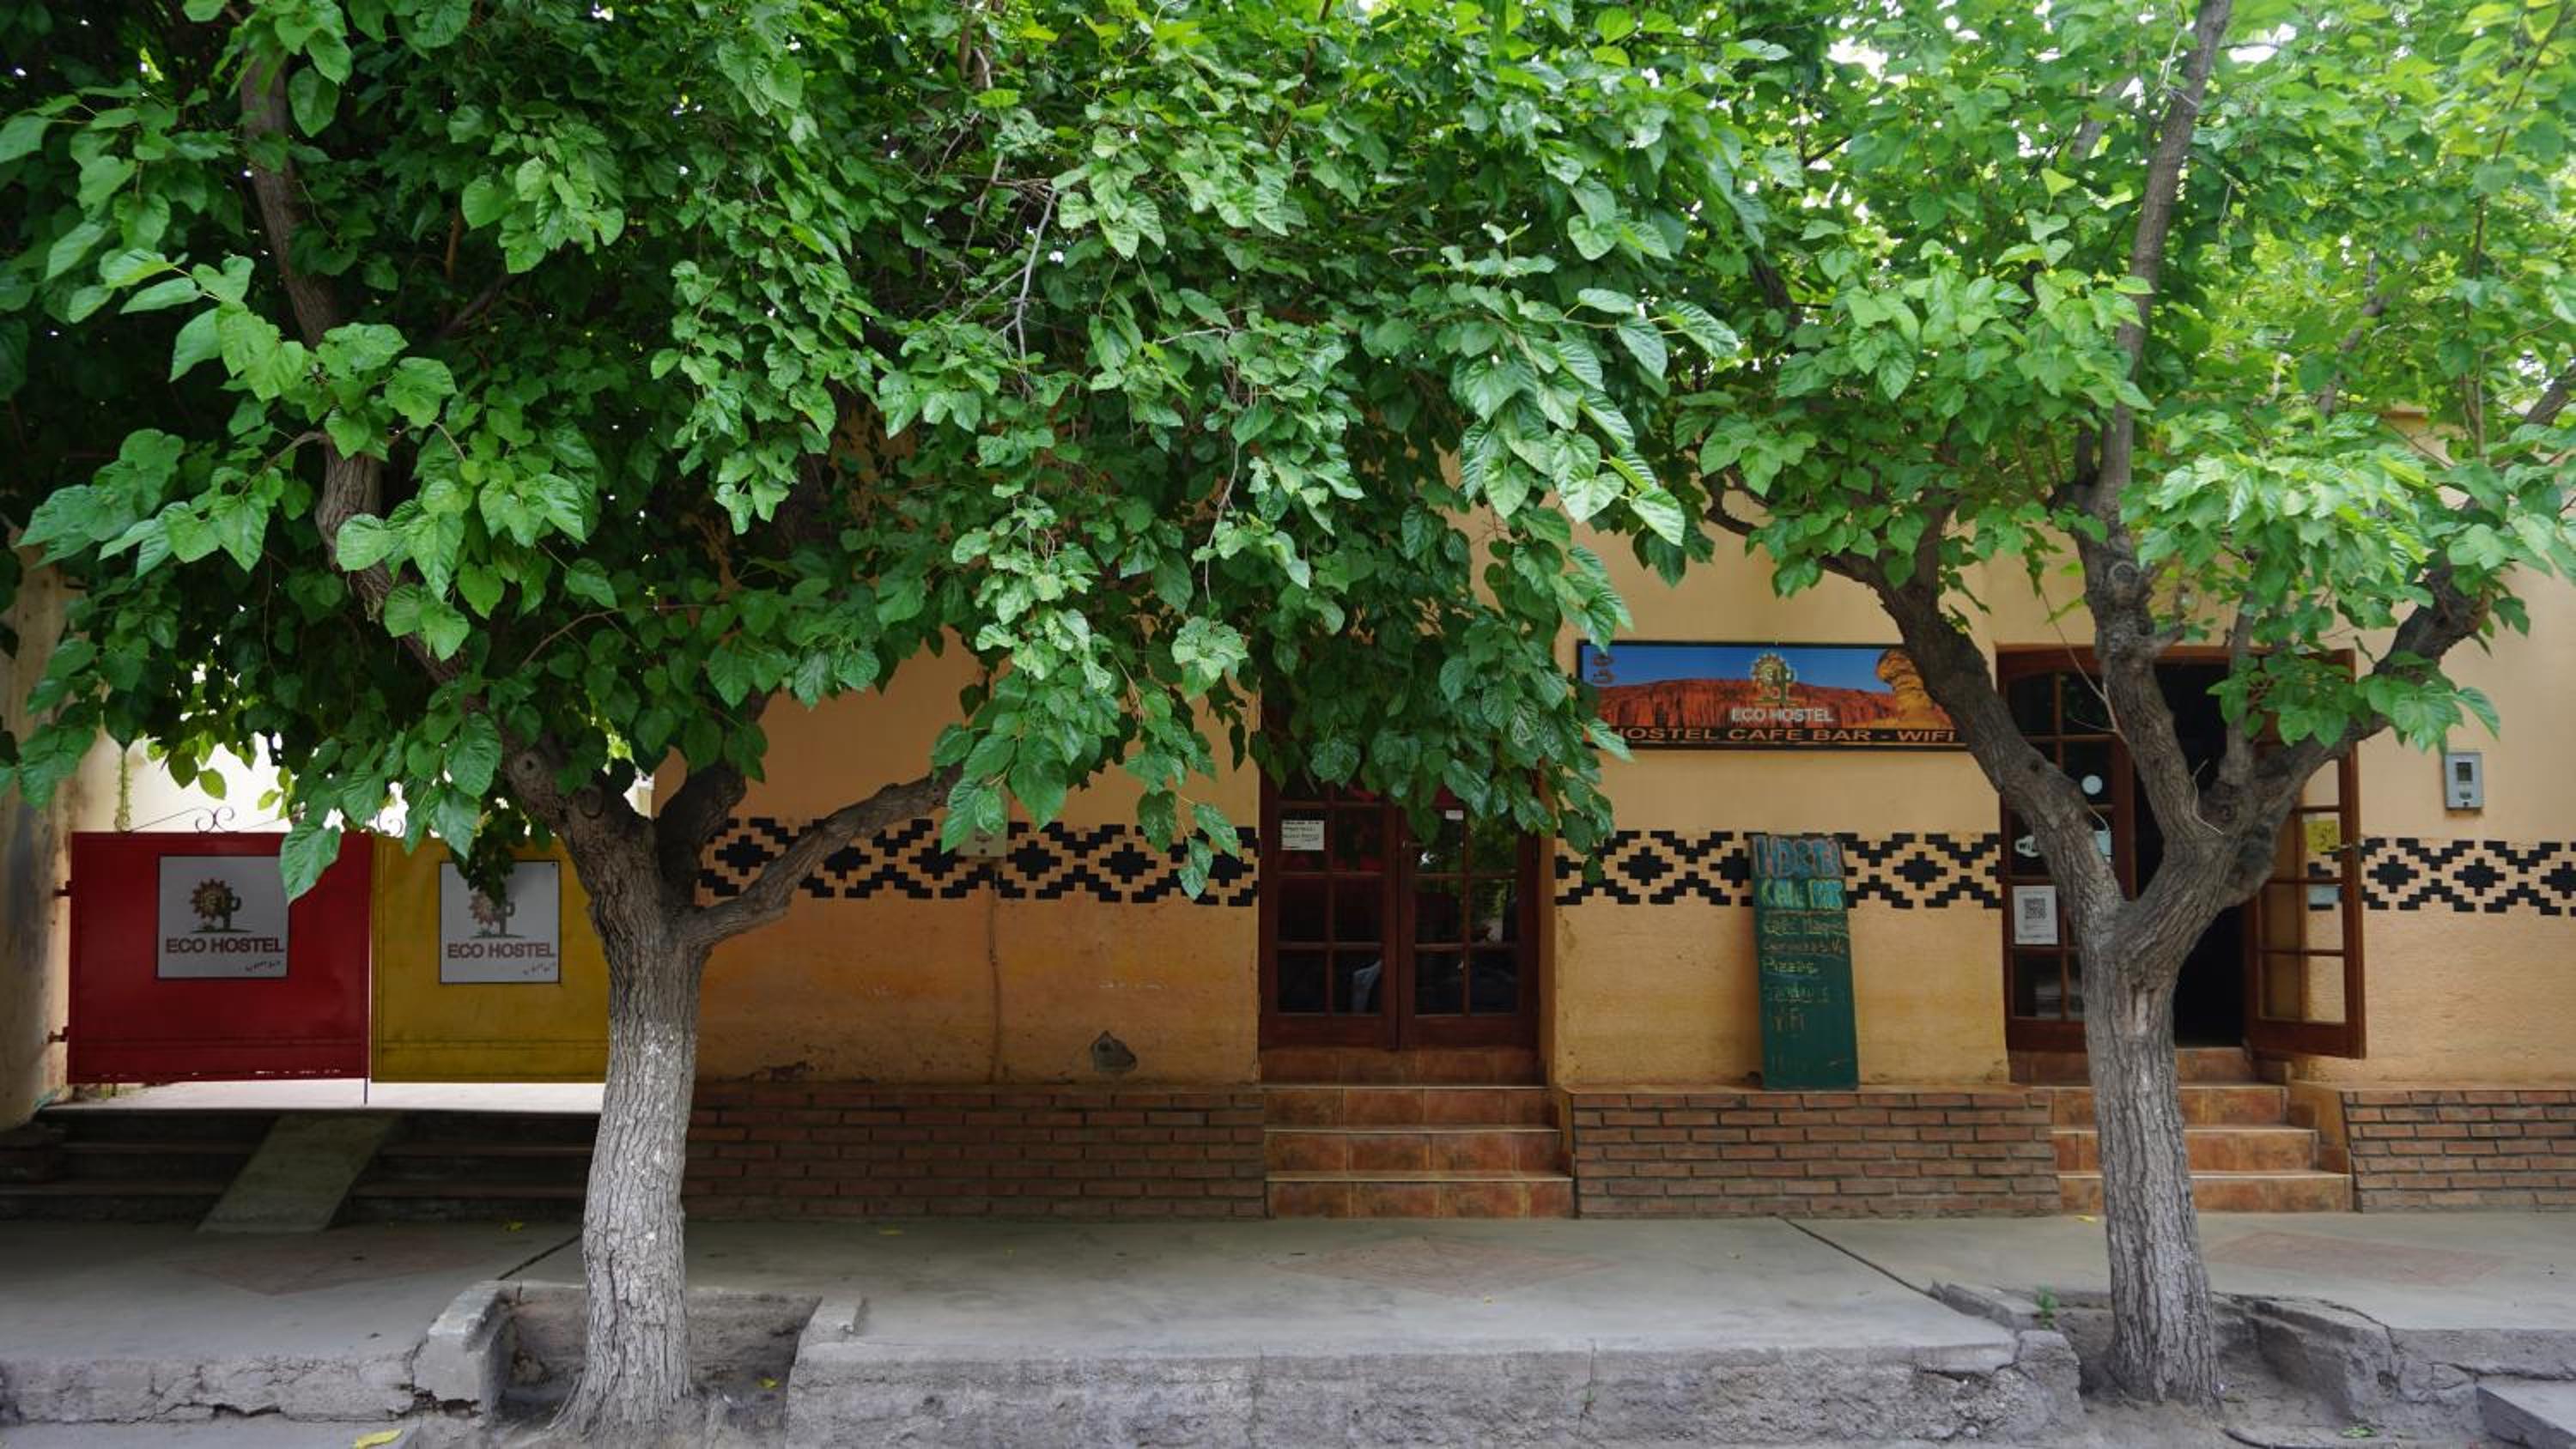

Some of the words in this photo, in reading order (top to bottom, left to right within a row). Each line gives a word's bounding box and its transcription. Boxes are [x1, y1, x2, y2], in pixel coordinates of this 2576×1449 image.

[1730, 706, 1766, 722] ECO
[1769, 707, 1834, 723] HOSTEL
[1728, 728, 1805, 741] CAFE
[1812, 729, 1872, 742] BAR
[1896, 730, 1956, 743] WIFI
[166, 937, 206, 954] ECO
[210, 937, 285, 954] HOSTEL
[447, 943, 483, 958] ECO
[488, 943, 556, 959] HOSTEL
